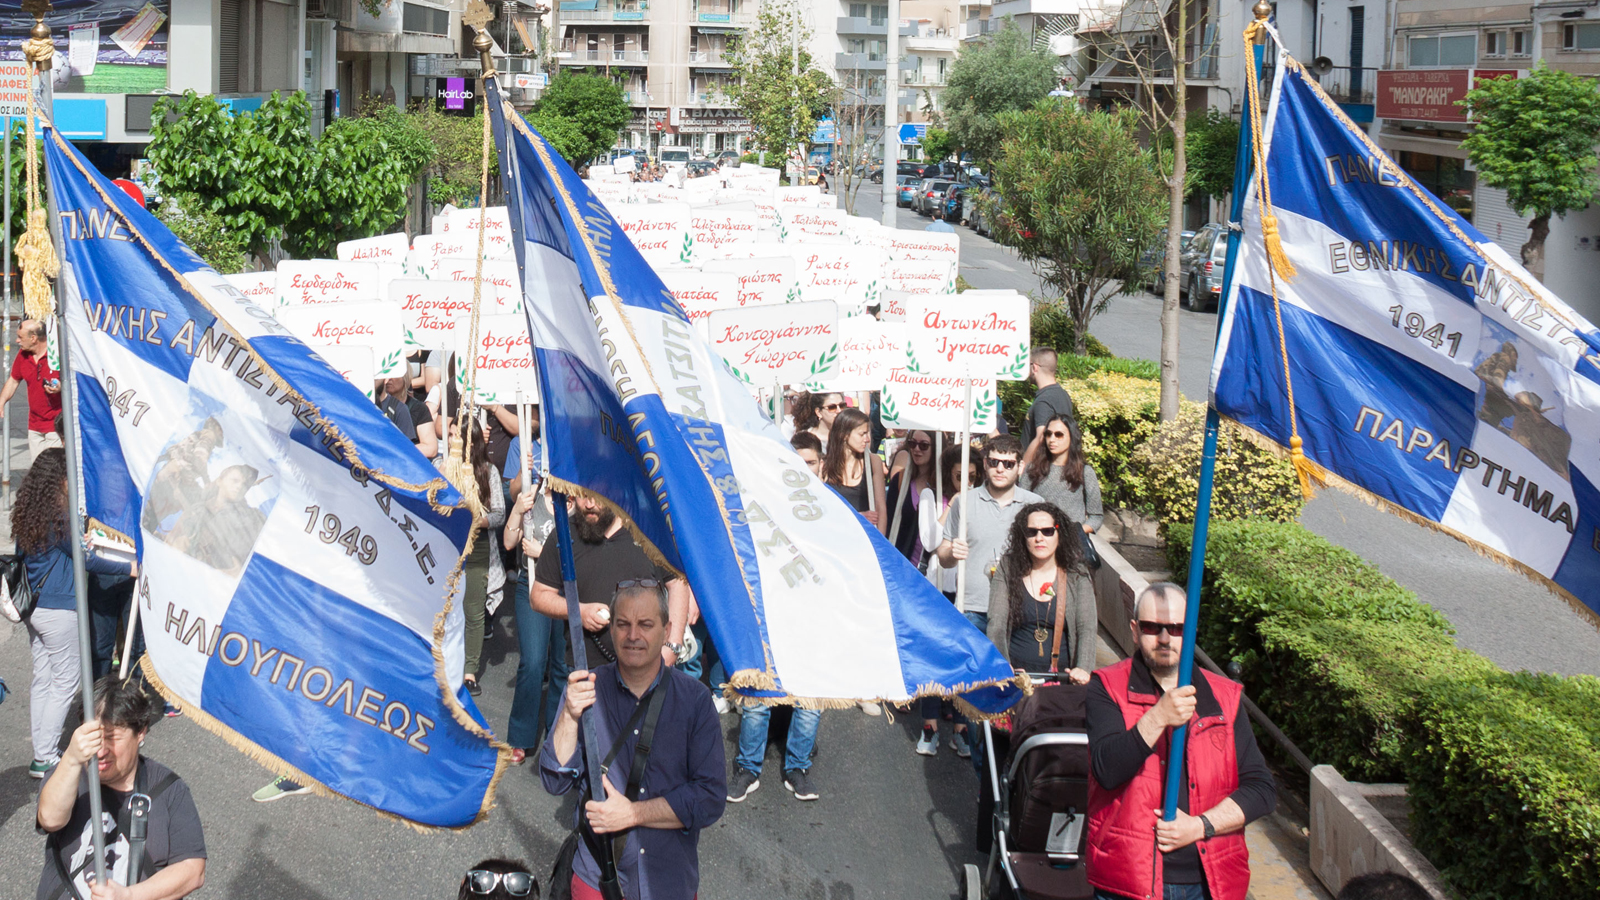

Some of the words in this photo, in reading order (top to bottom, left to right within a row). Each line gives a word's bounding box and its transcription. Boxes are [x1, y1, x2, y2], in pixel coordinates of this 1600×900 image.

[438, 90, 473, 99] HairLab
[466, 217, 503, 229] Στθης
[1329, 239, 1457, 281] ΕΘΝΙΚΗΣ
[84, 299, 168, 346] ΝΙΚΗΣ
[416, 315, 455, 330] Πάνο
[716, 321, 831, 346] Κοντογιάννης
[1389, 304, 1463, 358] 1941
[1353, 405, 1574, 534] ΠΑΡΑΡΤΗΜΑ
[304, 505, 379, 567] 1949
[164, 601, 436, 755] ΗΛΙΟΥΠΟΛΕΩΣ
